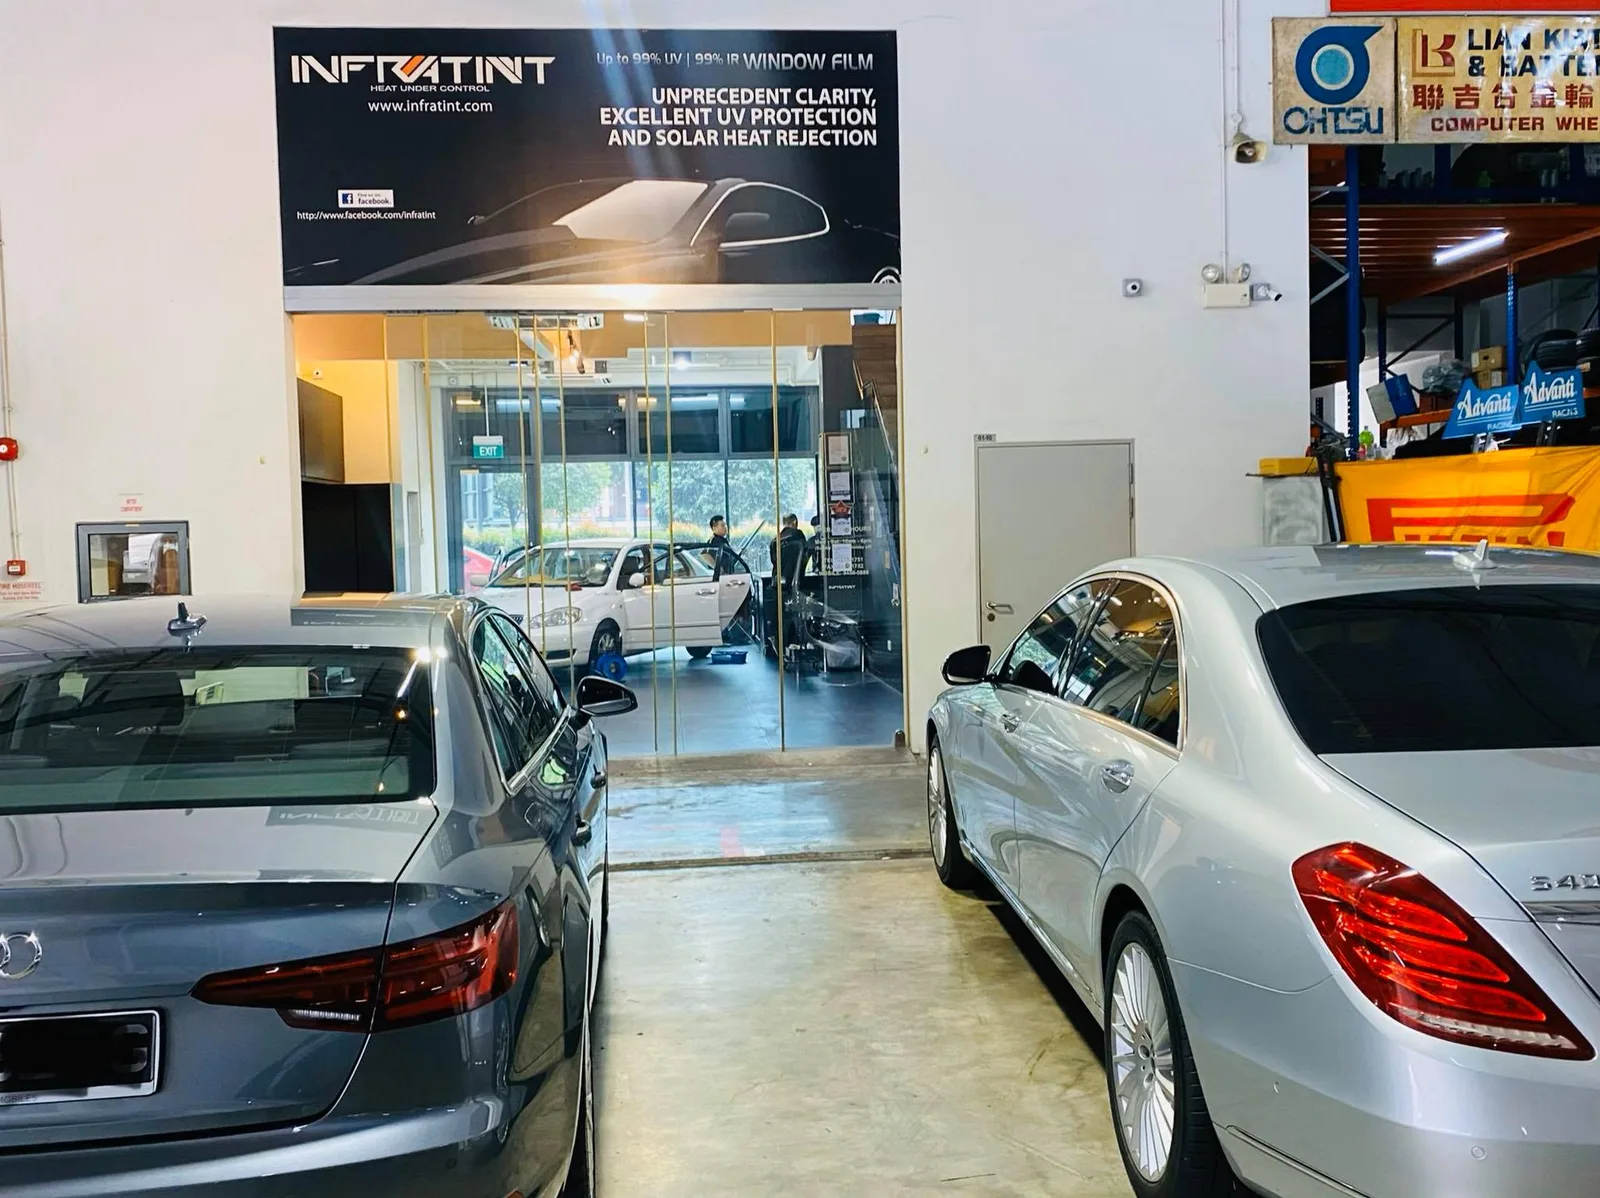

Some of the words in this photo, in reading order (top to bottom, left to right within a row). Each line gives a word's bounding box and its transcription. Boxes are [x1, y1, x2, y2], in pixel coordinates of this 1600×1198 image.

[1468, 28, 1531, 50] LIAN
[291, 54, 556, 85] INFRATINT
[596, 53, 614, 67] Up
[616, 53, 629, 64] to
[632, 53, 662, 64] 99%
[665, 53, 682, 64] UV
[695, 53, 724, 65] 99%
[727, 54, 739, 65] IR
[743, 53, 826, 70] WINDOW
[831, 54, 874, 70] FILM
[1468, 55, 1486, 77] &
[368, 99, 493, 112] www.infratint.com
[652, 88, 791, 105] UNPRECEDENT
[795, 88, 877, 108] CLARITY,
[600, 107, 712, 125] EXCELLENT
[717, 108, 745, 125] UV
[751, 108, 877, 125] PROTECTION
[1283, 107, 1384, 134] OHTSU
[1431, 117, 1544, 132] COMPUTER
[608, 129, 651, 146] AND
[656, 129, 718, 146] SOLAR
[723, 129, 772, 146] HEAT
[776, 129, 877, 146] REJECTION
[297, 210, 436, 220] http://www.facebook.com/infratint
[1523, 372, 1576, 405] Advanti
[1457, 389, 1512, 420] Advanti
[479, 446, 498, 456] EXIT
